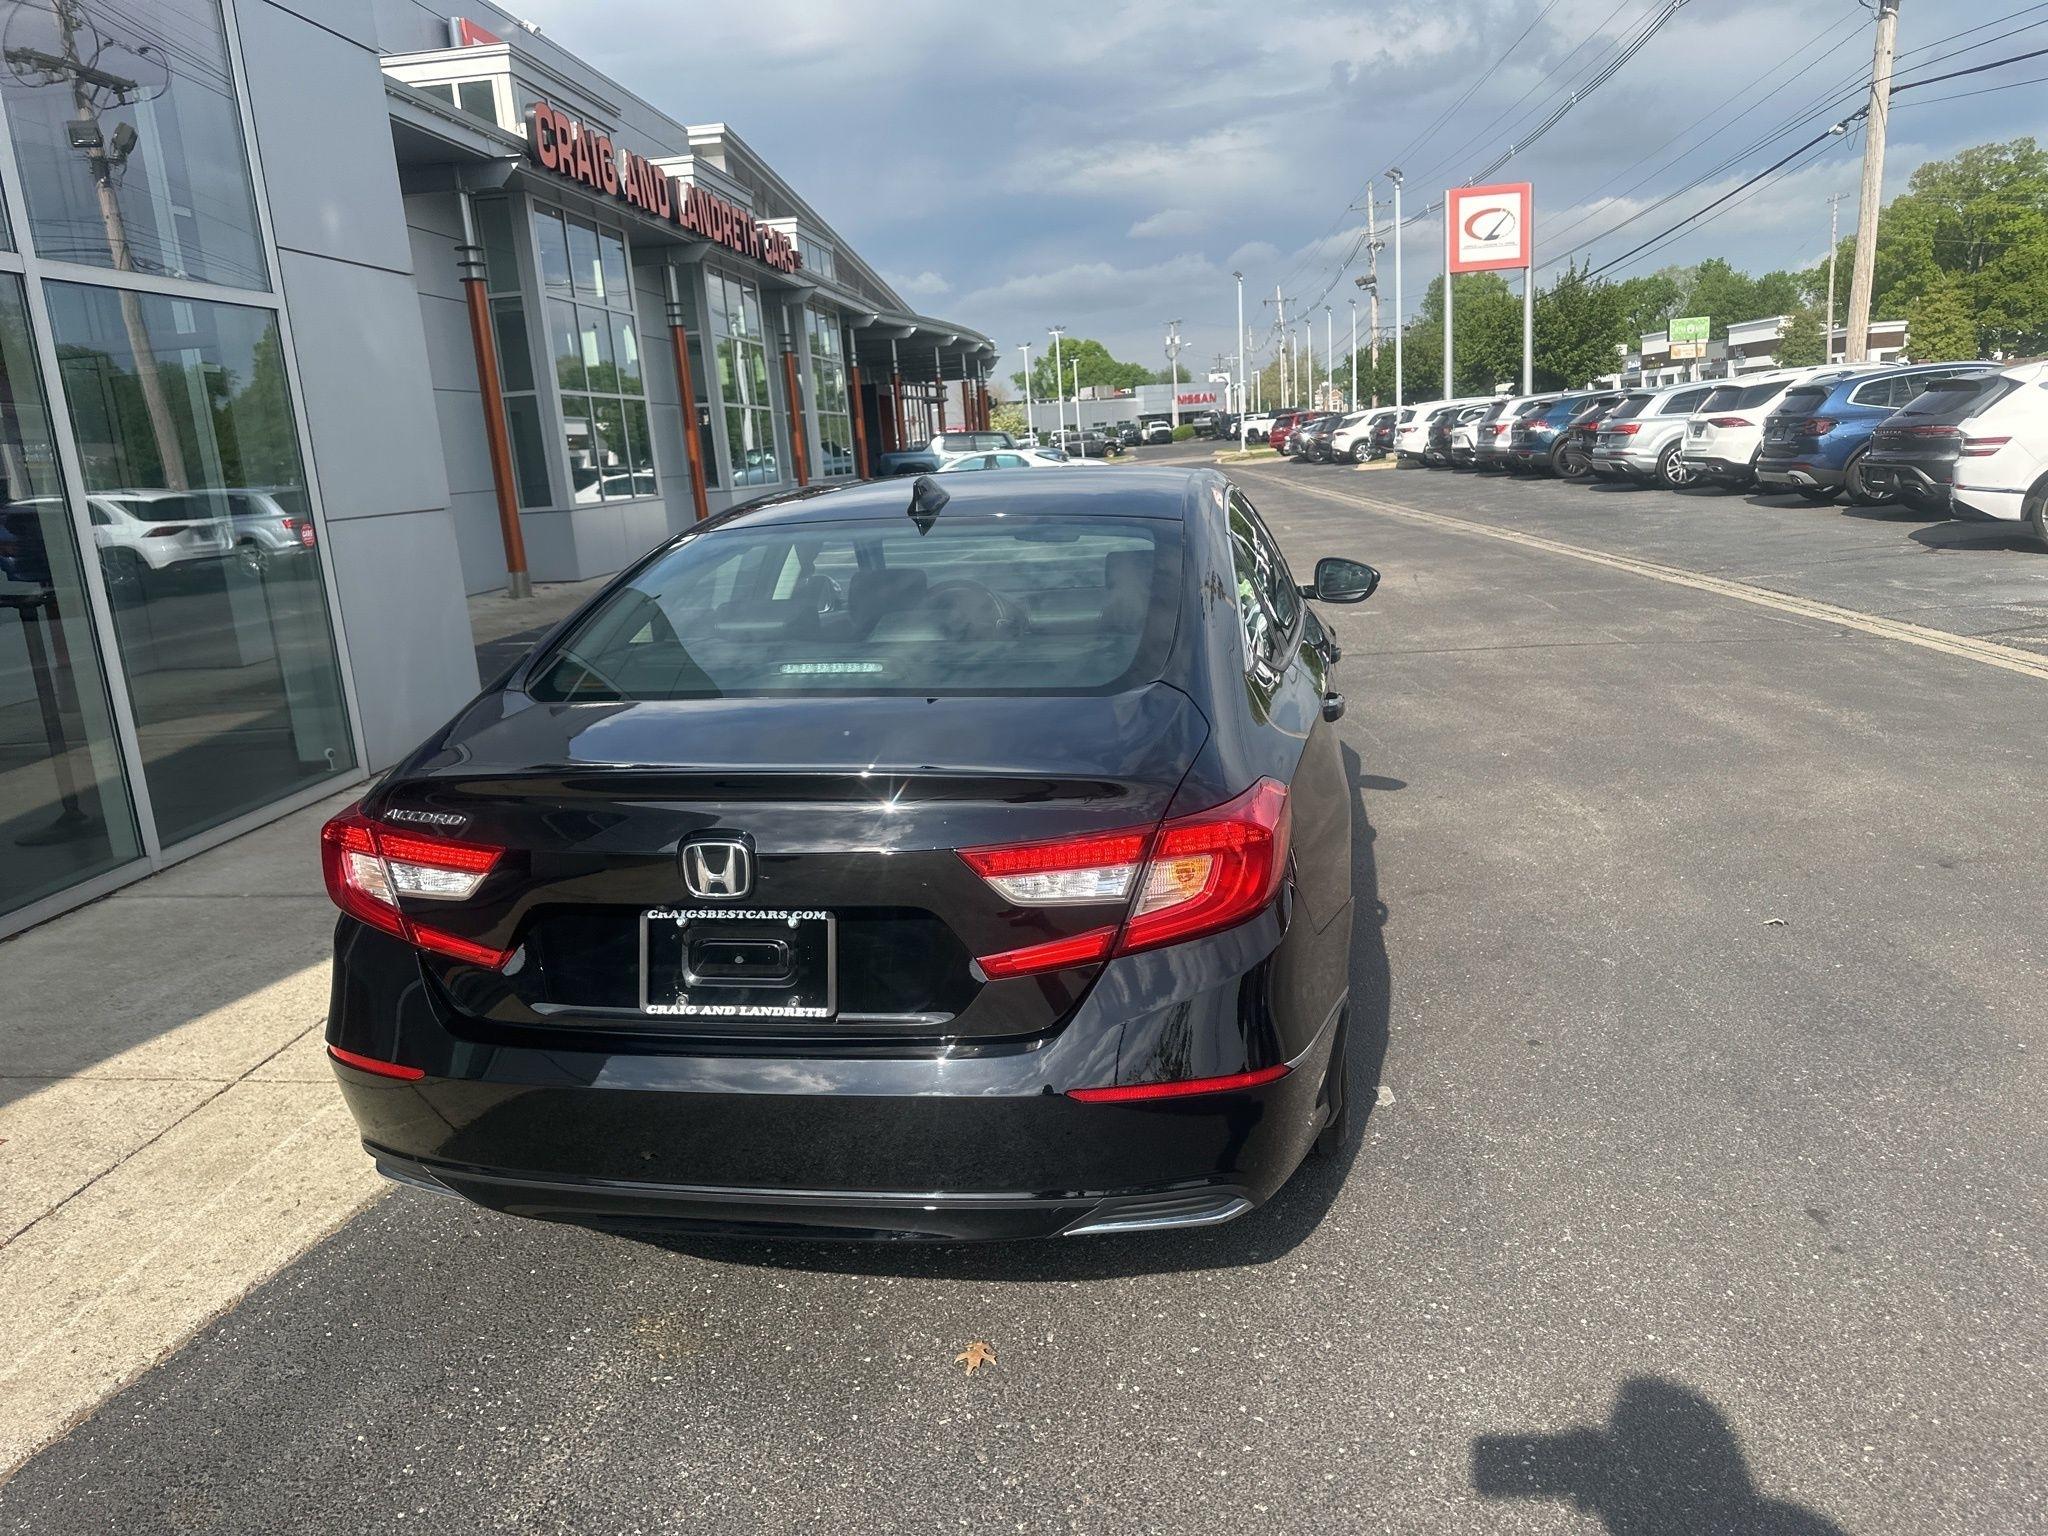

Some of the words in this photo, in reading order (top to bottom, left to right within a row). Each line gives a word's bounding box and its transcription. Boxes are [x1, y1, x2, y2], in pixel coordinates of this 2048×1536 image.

[533, 100, 618, 196] CRAIG
[624, 149, 671, 219] AND
[676, 177, 761, 259] LANDRETH
[761, 223, 796, 275] CARS
[1177, 392, 1217, 406] NISSAN
[384, 808, 467, 826] ACCORD
[647, 909, 827, 920] CRAIGSBESTCARS.COM
[646, 1005, 697, 1015] CRAIG
[700, 1005, 736, 1016] AND
[739, 1006, 828, 1017] LANDRETH
